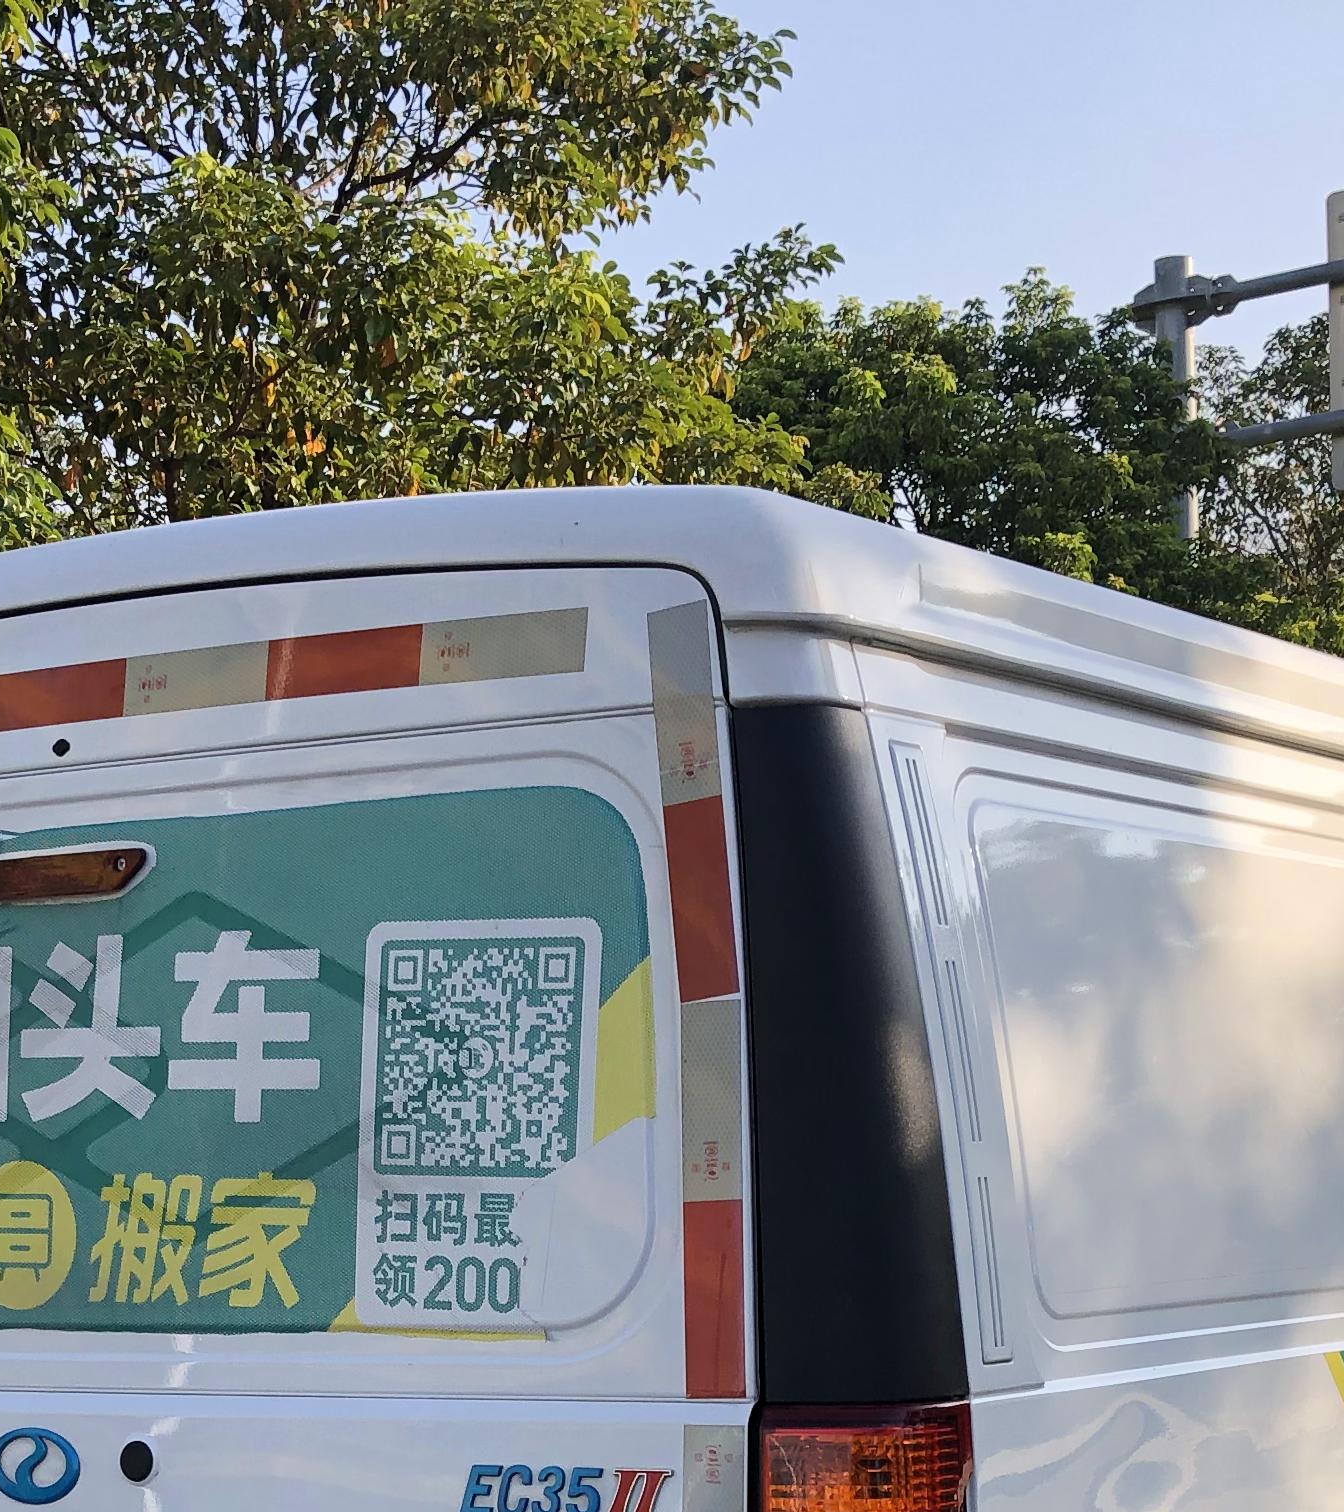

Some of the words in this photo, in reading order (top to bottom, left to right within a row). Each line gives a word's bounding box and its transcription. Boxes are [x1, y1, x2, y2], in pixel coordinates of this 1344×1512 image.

[88, 1172, 317, 1309] 搬家
[374, 1190, 522, 1247] 扫码最
[373, 1253, 521, 1313] 领200
